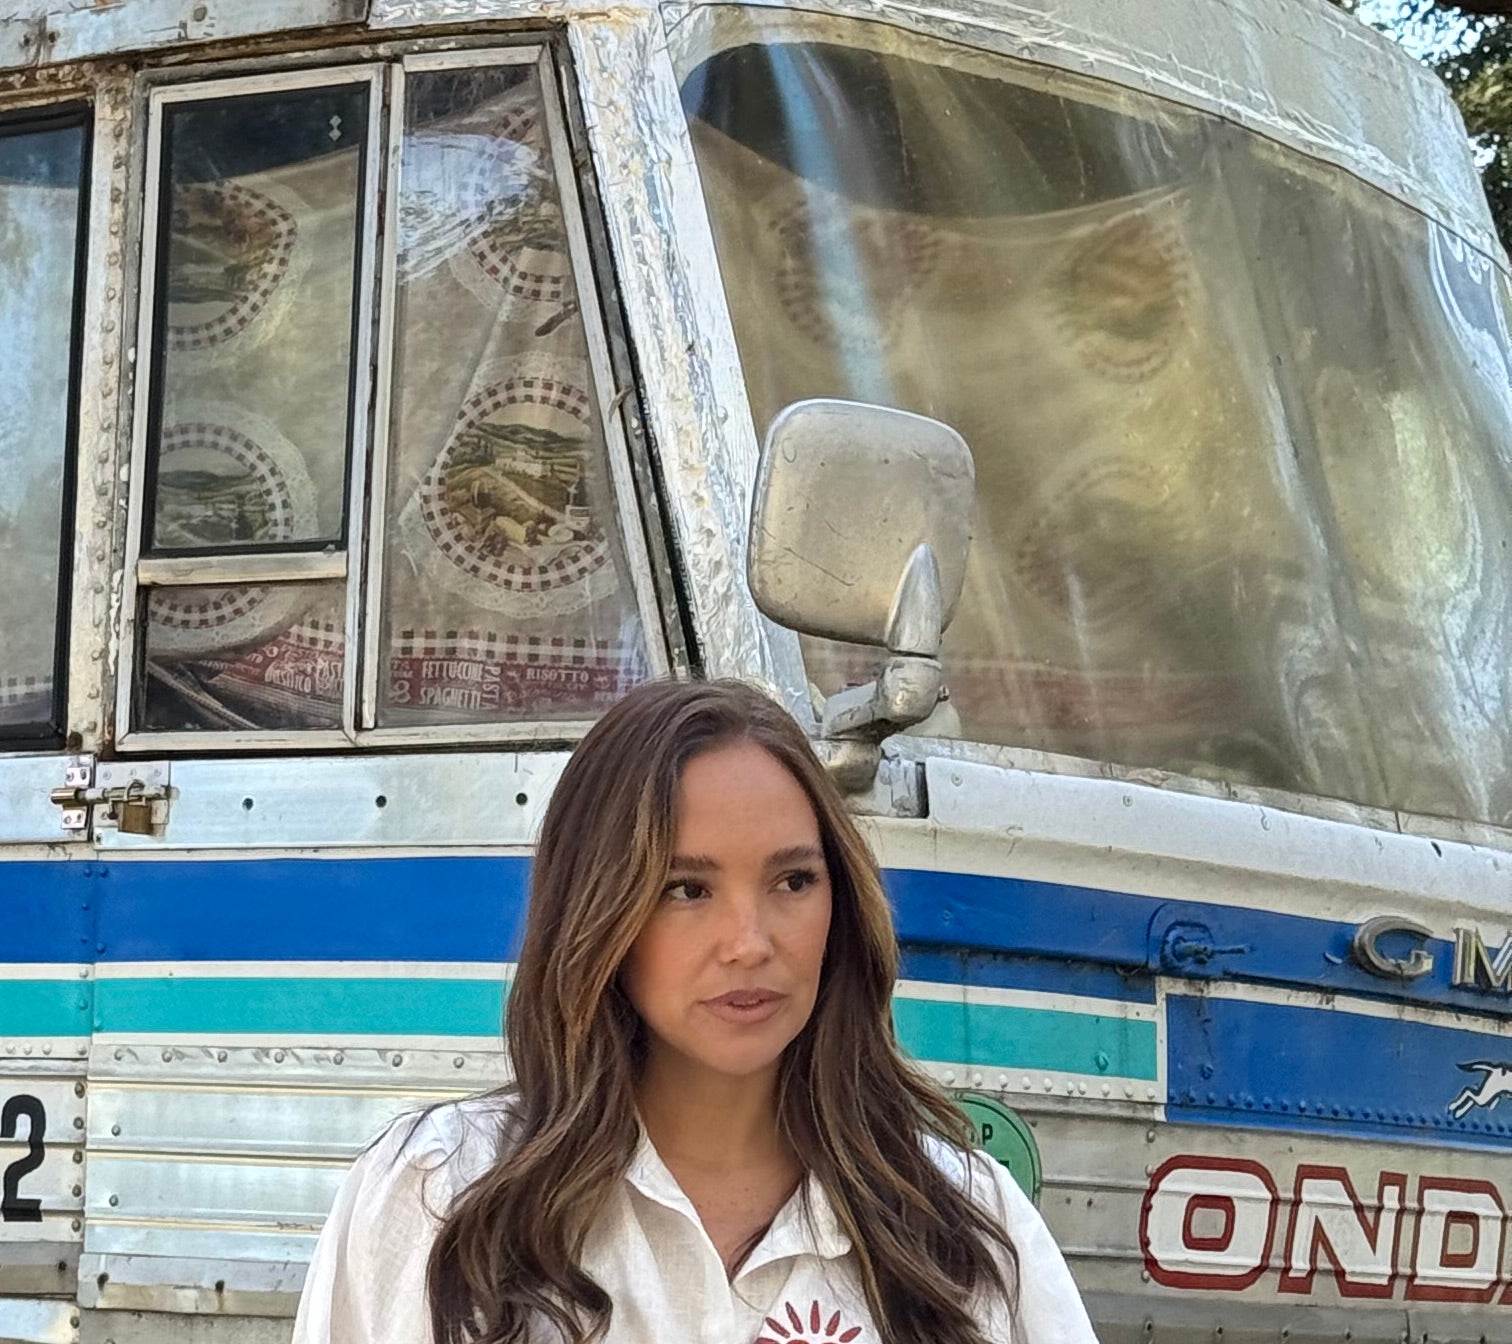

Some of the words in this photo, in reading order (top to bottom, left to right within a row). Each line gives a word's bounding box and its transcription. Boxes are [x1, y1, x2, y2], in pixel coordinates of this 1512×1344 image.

[526, 667, 590, 683] RISOTTO
[419, 686, 482, 710] SPAGHETTI
[1140, 1155, 1512, 1305] OND
